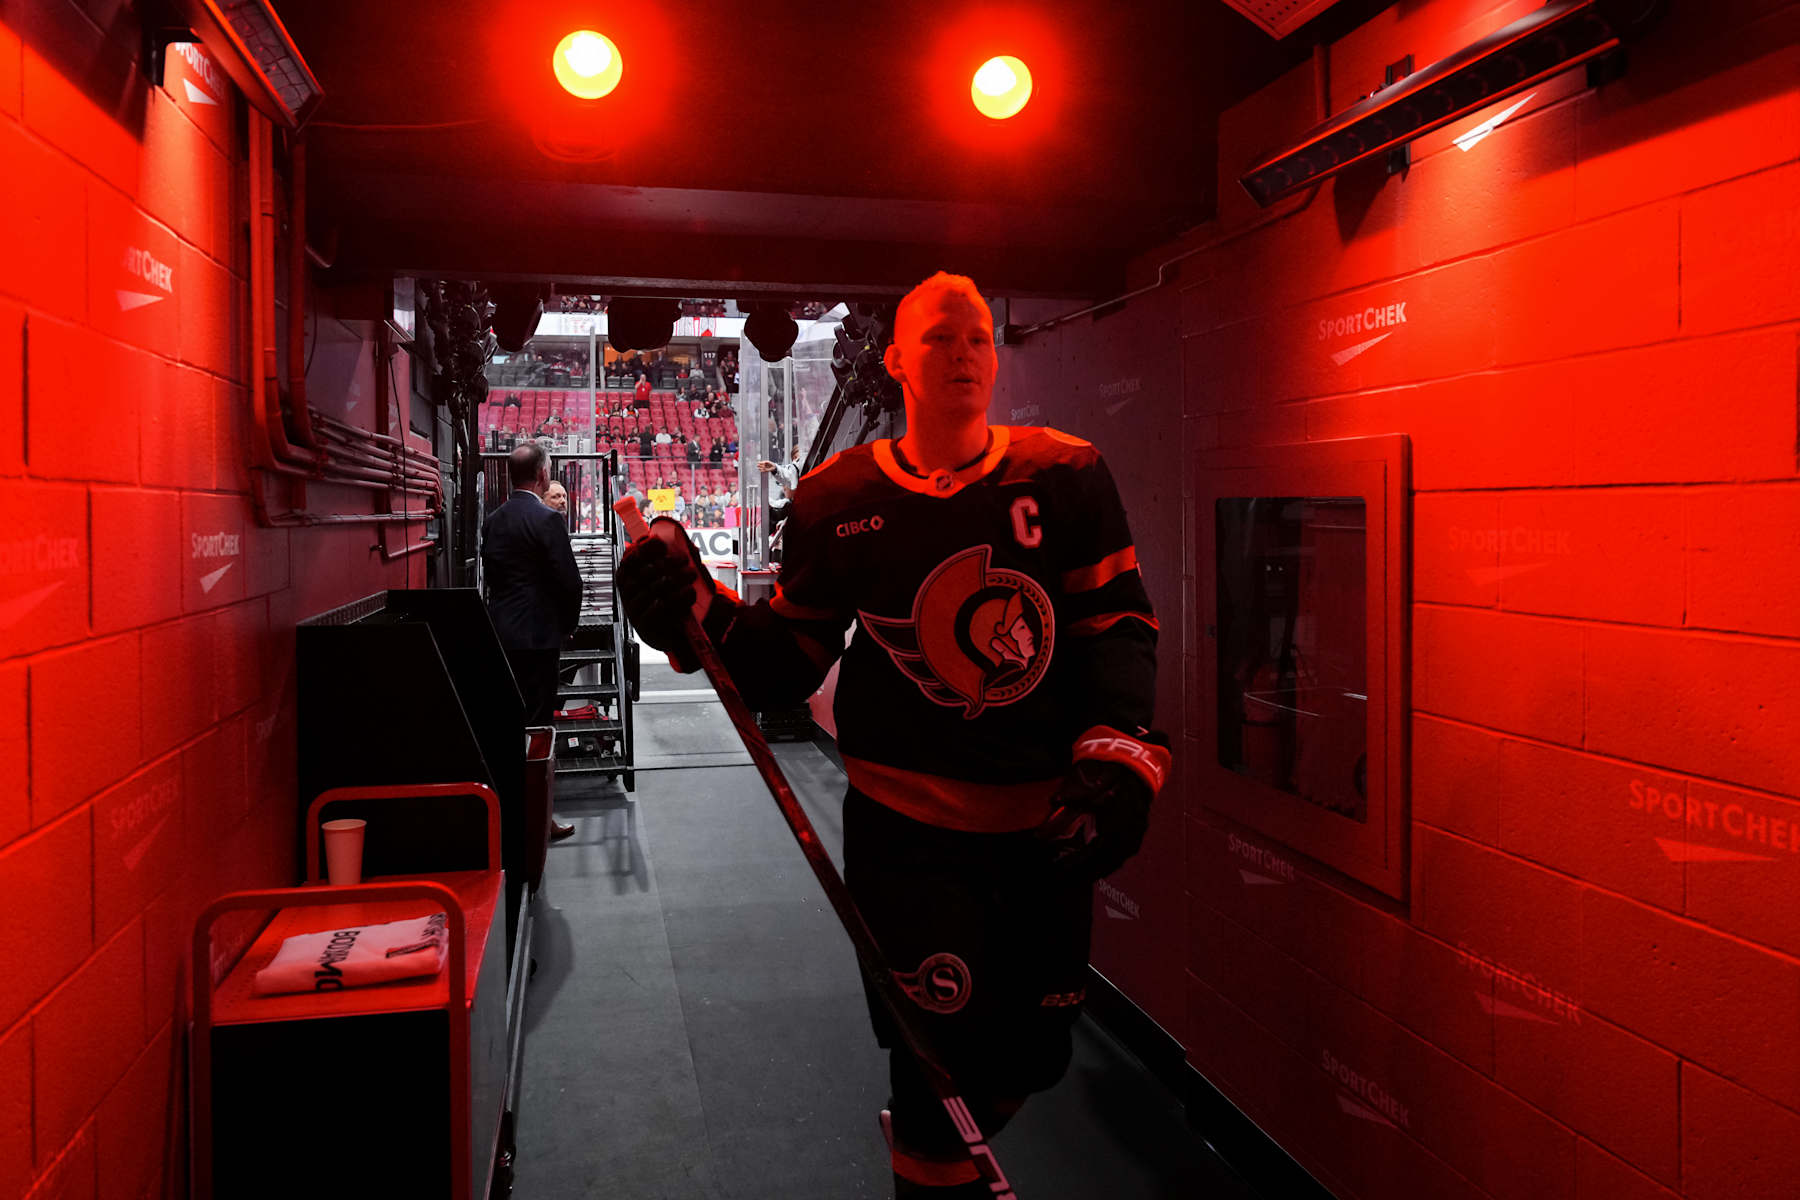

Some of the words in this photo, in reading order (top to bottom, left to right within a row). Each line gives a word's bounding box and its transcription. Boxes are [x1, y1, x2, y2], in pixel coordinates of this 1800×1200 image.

[1318, 302, 1407, 341] SPORTCHEK
[836, 519, 870, 537] CIBC
[1008, 496, 1043, 549] C
[192, 531, 240, 559] SPORTCHEK
